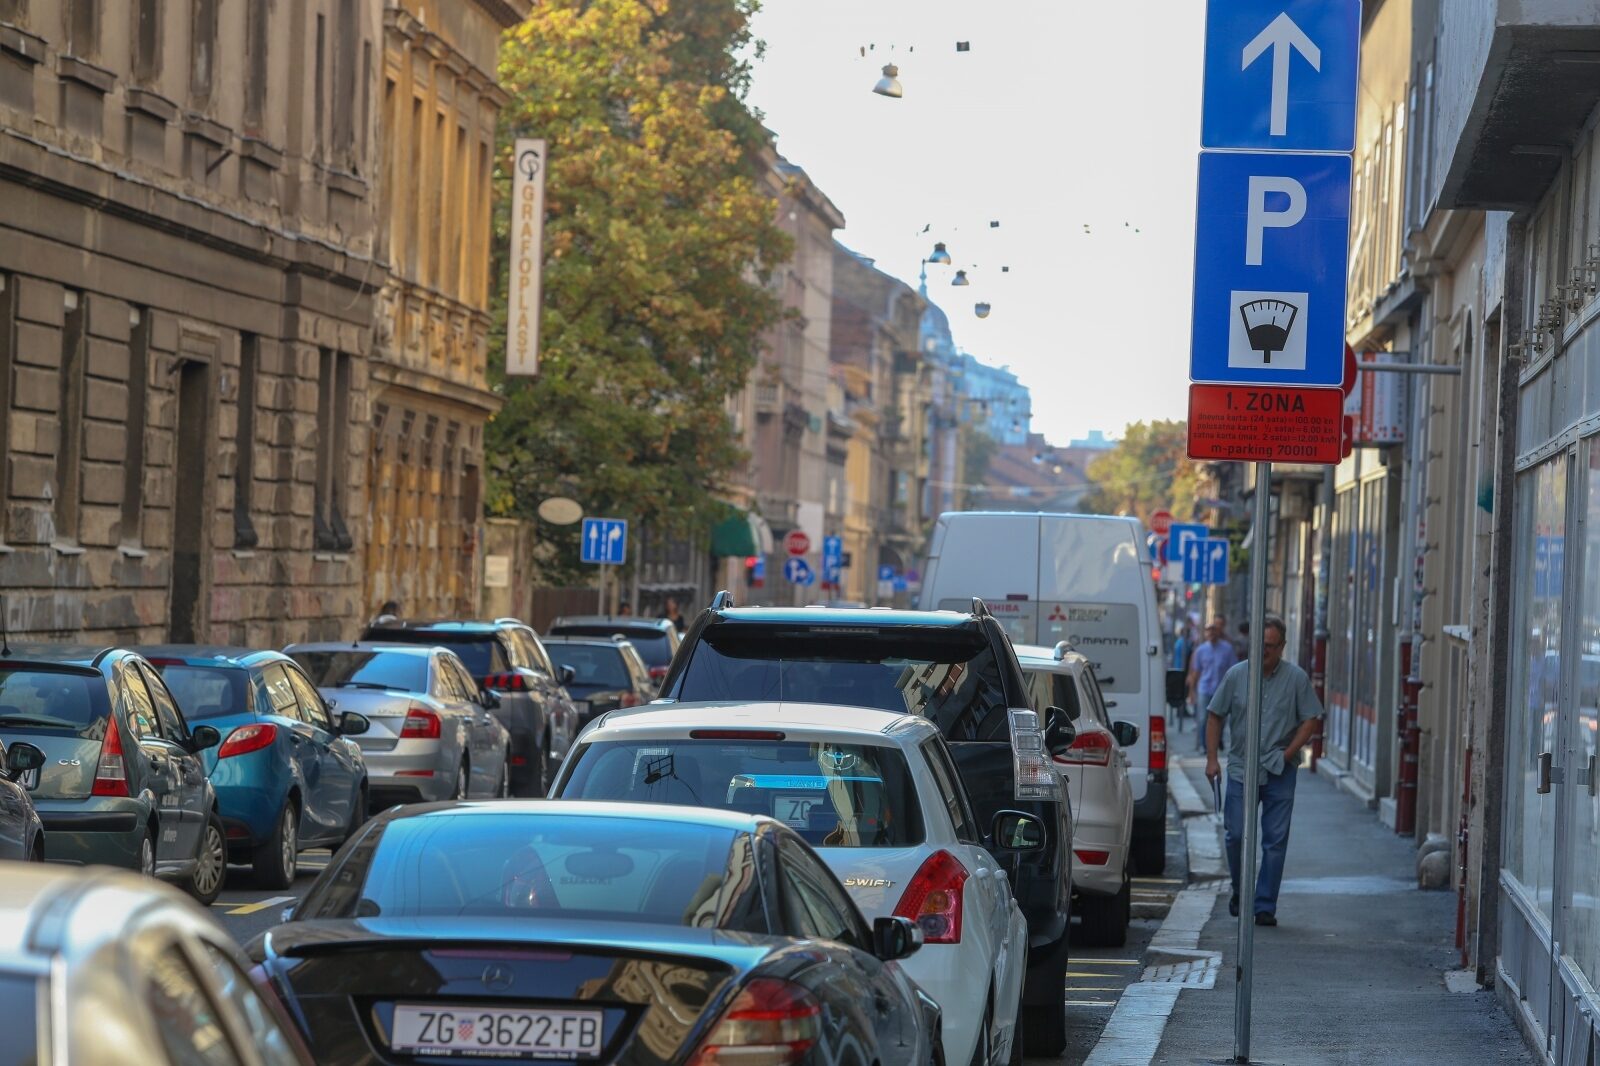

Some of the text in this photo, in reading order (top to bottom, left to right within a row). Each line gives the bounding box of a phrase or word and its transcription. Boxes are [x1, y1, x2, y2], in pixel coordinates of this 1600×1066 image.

[1246, 176, 1307, 265] P
[517, 185, 535, 365] GRAFOPLAST
[1227, 391, 1305, 412] 1. ZONA
[1211, 444, 1318, 458] m-parking 700101
[1083, 637, 1128, 646] MANTA
[844, 878, 896, 888] SWIFT
[417, 1012, 454, 1044] ZG
